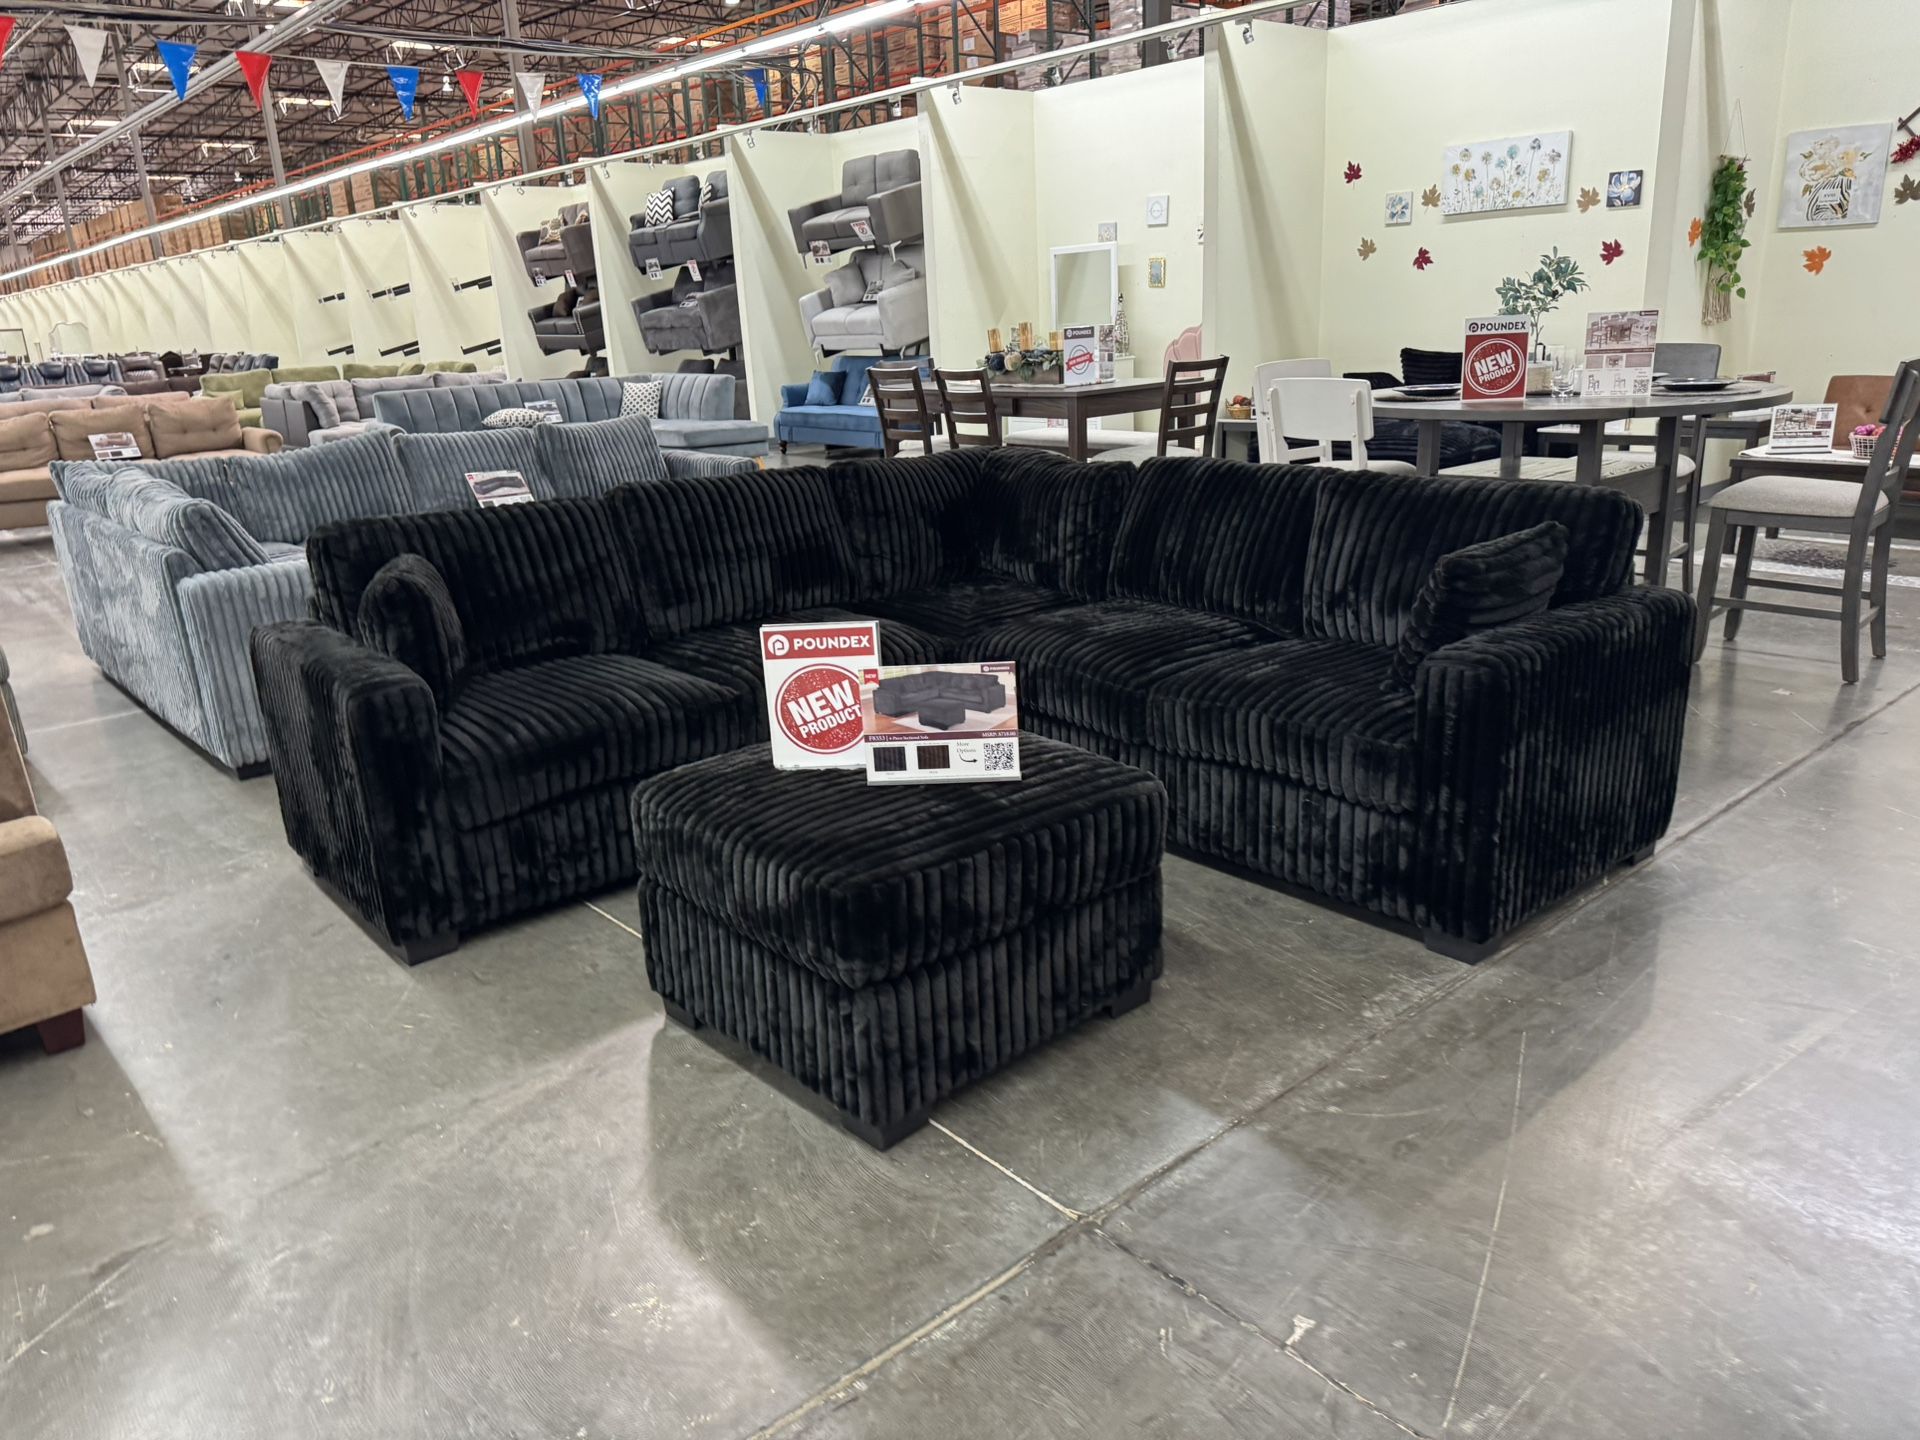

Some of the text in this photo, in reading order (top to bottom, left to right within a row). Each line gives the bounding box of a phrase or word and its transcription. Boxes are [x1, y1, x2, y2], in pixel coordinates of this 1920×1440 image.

[1480, 321, 1527, 332] POUNDEX
[1473, 348, 1514, 377] NEW
[1478, 363, 1516, 384] PRODUCT
[793, 635, 870, 650] POUNDEX
[786, 679, 856, 727] NEW
[799, 704, 863, 739] PRODUCT
